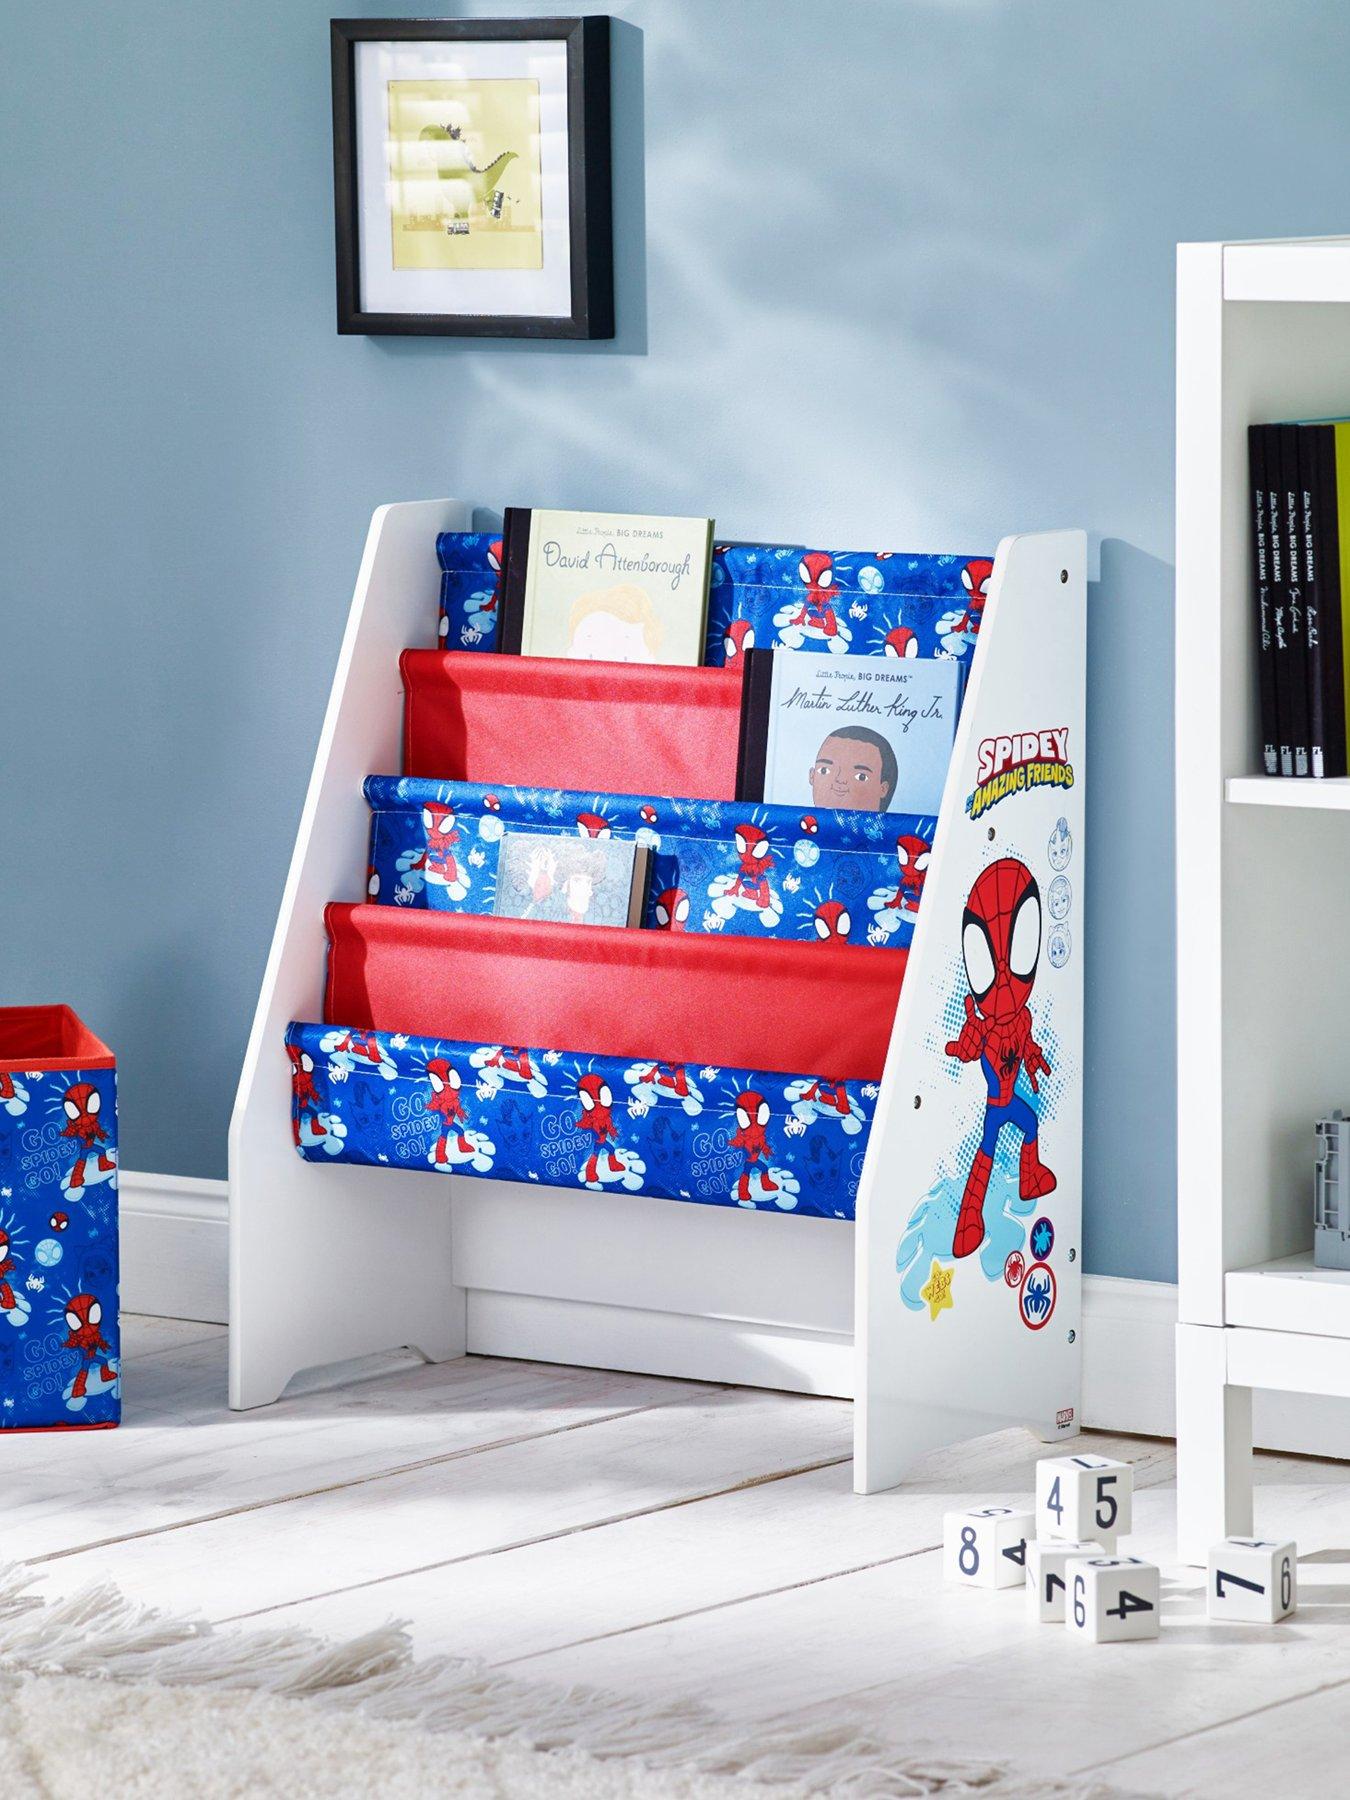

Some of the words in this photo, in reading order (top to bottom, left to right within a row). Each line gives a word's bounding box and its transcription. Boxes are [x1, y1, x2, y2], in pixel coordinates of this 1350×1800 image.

[616, 529, 630, 537] BIG
[632, 530, 663, 539] DREAMS
[1272, 534, 1280, 549] BIG
[1289, 534, 1297, 549] BIG
[1305, 534, 1313, 549] BIG
[543, 541, 590, 569] David
[595, 542, 690, 591] Attenborough
[1258, 548, 1266, 581] DREAMS
[1273, 550, 1281, 583] DREAMS
[1290, 550, 1298, 583] DREAMS
[1306, 550, 1314, 583] DREAMS
[858, 672, 872, 681] BIG
[780, 686, 832, 710] Martin
[836, 690, 882, 714] Luther
[884, 693, 917, 733] King
[977, 727, 1069, 785] SPIDEY
[970, 765, 1026, 821] AMAZING
[1024, 762, 1074, 791] FRIENDS
[392, 1091, 428, 1122] GO
[21, 1121, 64, 1152] GO
[391, 1114, 440, 1140] SPIDEY
[541, 1109, 578, 1140] GO
[21, 1139, 79, 1170] SPIDEY
[395, 1135, 428, 1159] GO!
[540, 1132, 592, 1159] SPIDEY
[692, 1127, 730, 1158] GO
[25, 1161, 62, 1189] GO!
[545, 1153, 578, 1177] GO!
[691, 1150, 743, 1177] SPIDEY
[697, 1172, 730, 1196] GO!
[24, 1332, 66, 1363] GO
[23, 1350, 80, 1381] SPIDEY
[27, 1372, 64, 1399] GO!
[1047, 1475, 1064, 1526] 4
[1095, 1475, 1118, 1529] 5
[958, 1526, 979, 1576] 8
[1002, 1537, 1027, 1566] 4
[1216, 1569, 1265, 1598] 7
[1074, 1574, 1085, 1628] 6
[1105, 1590, 1154, 1620] 4
